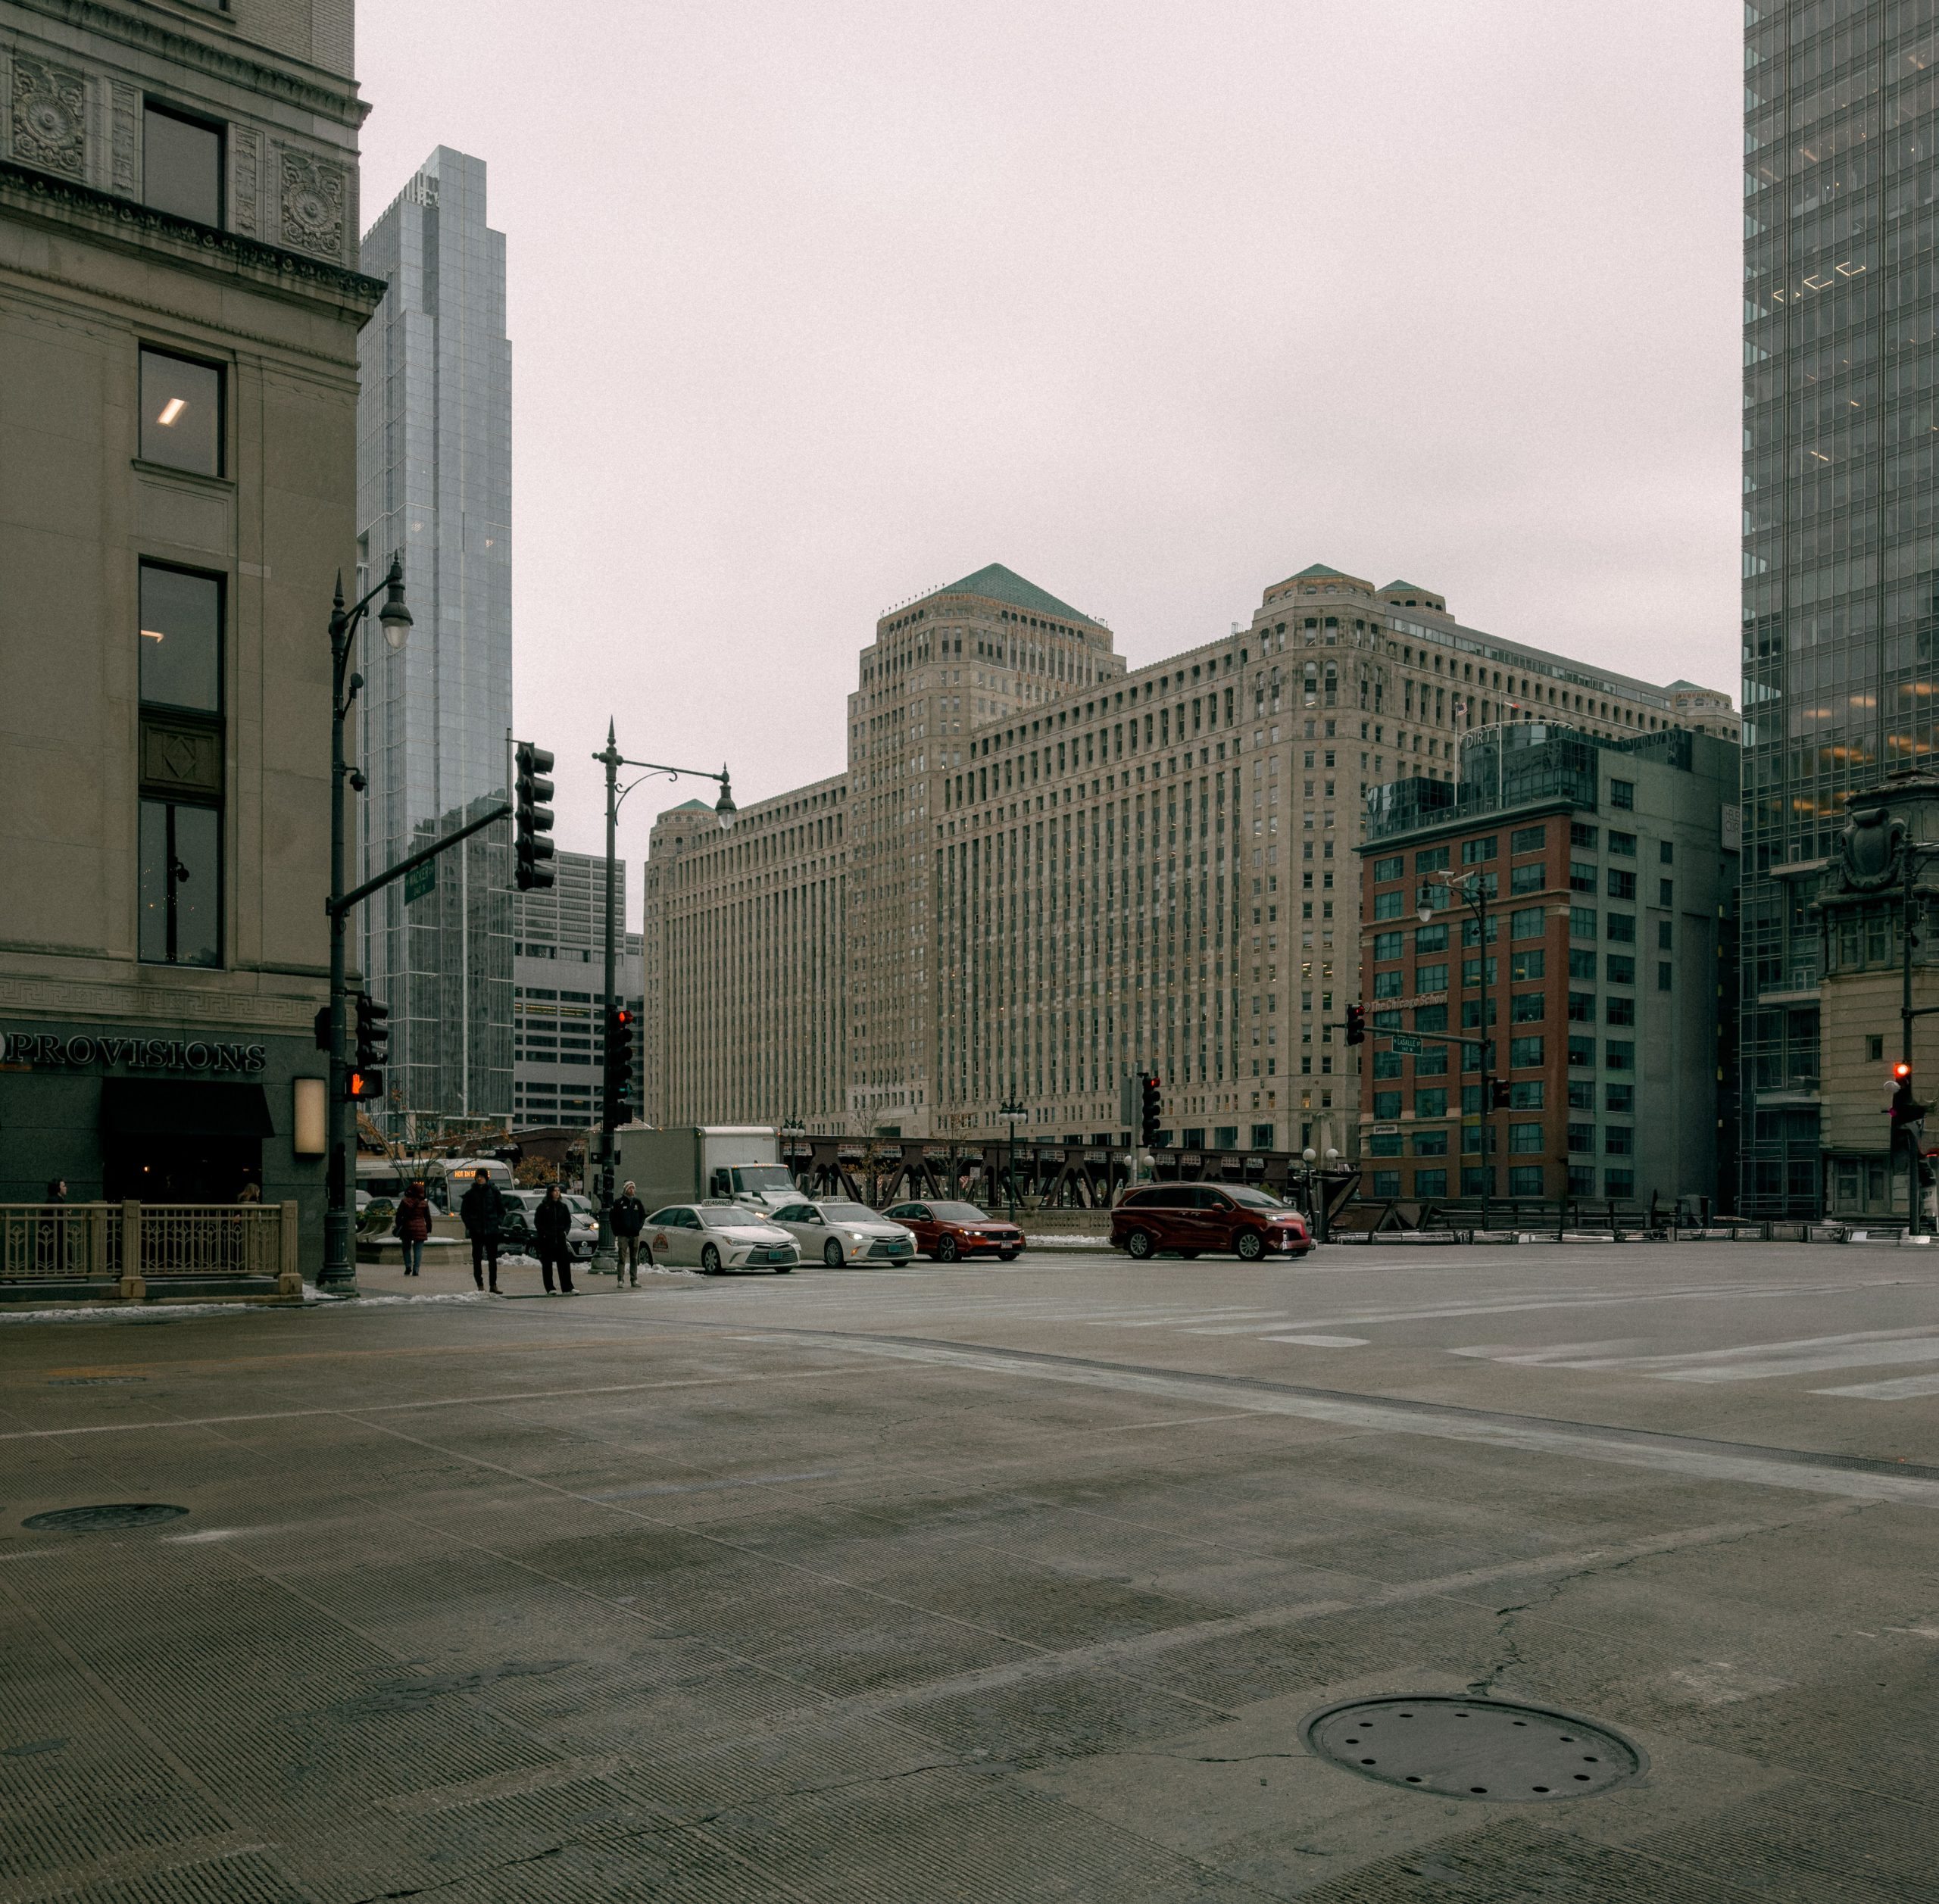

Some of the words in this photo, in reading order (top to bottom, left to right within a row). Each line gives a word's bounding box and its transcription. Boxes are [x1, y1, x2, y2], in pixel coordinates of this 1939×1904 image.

[1466, 727, 1502, 748] DIRTT
[1371, 1000, 1386, 1012] The
[1386, 997, 1419, 1010] Chicago
[1420, 991, 1448, 1006] School
[7, 1031, 267, 1073] PROVISIONS
